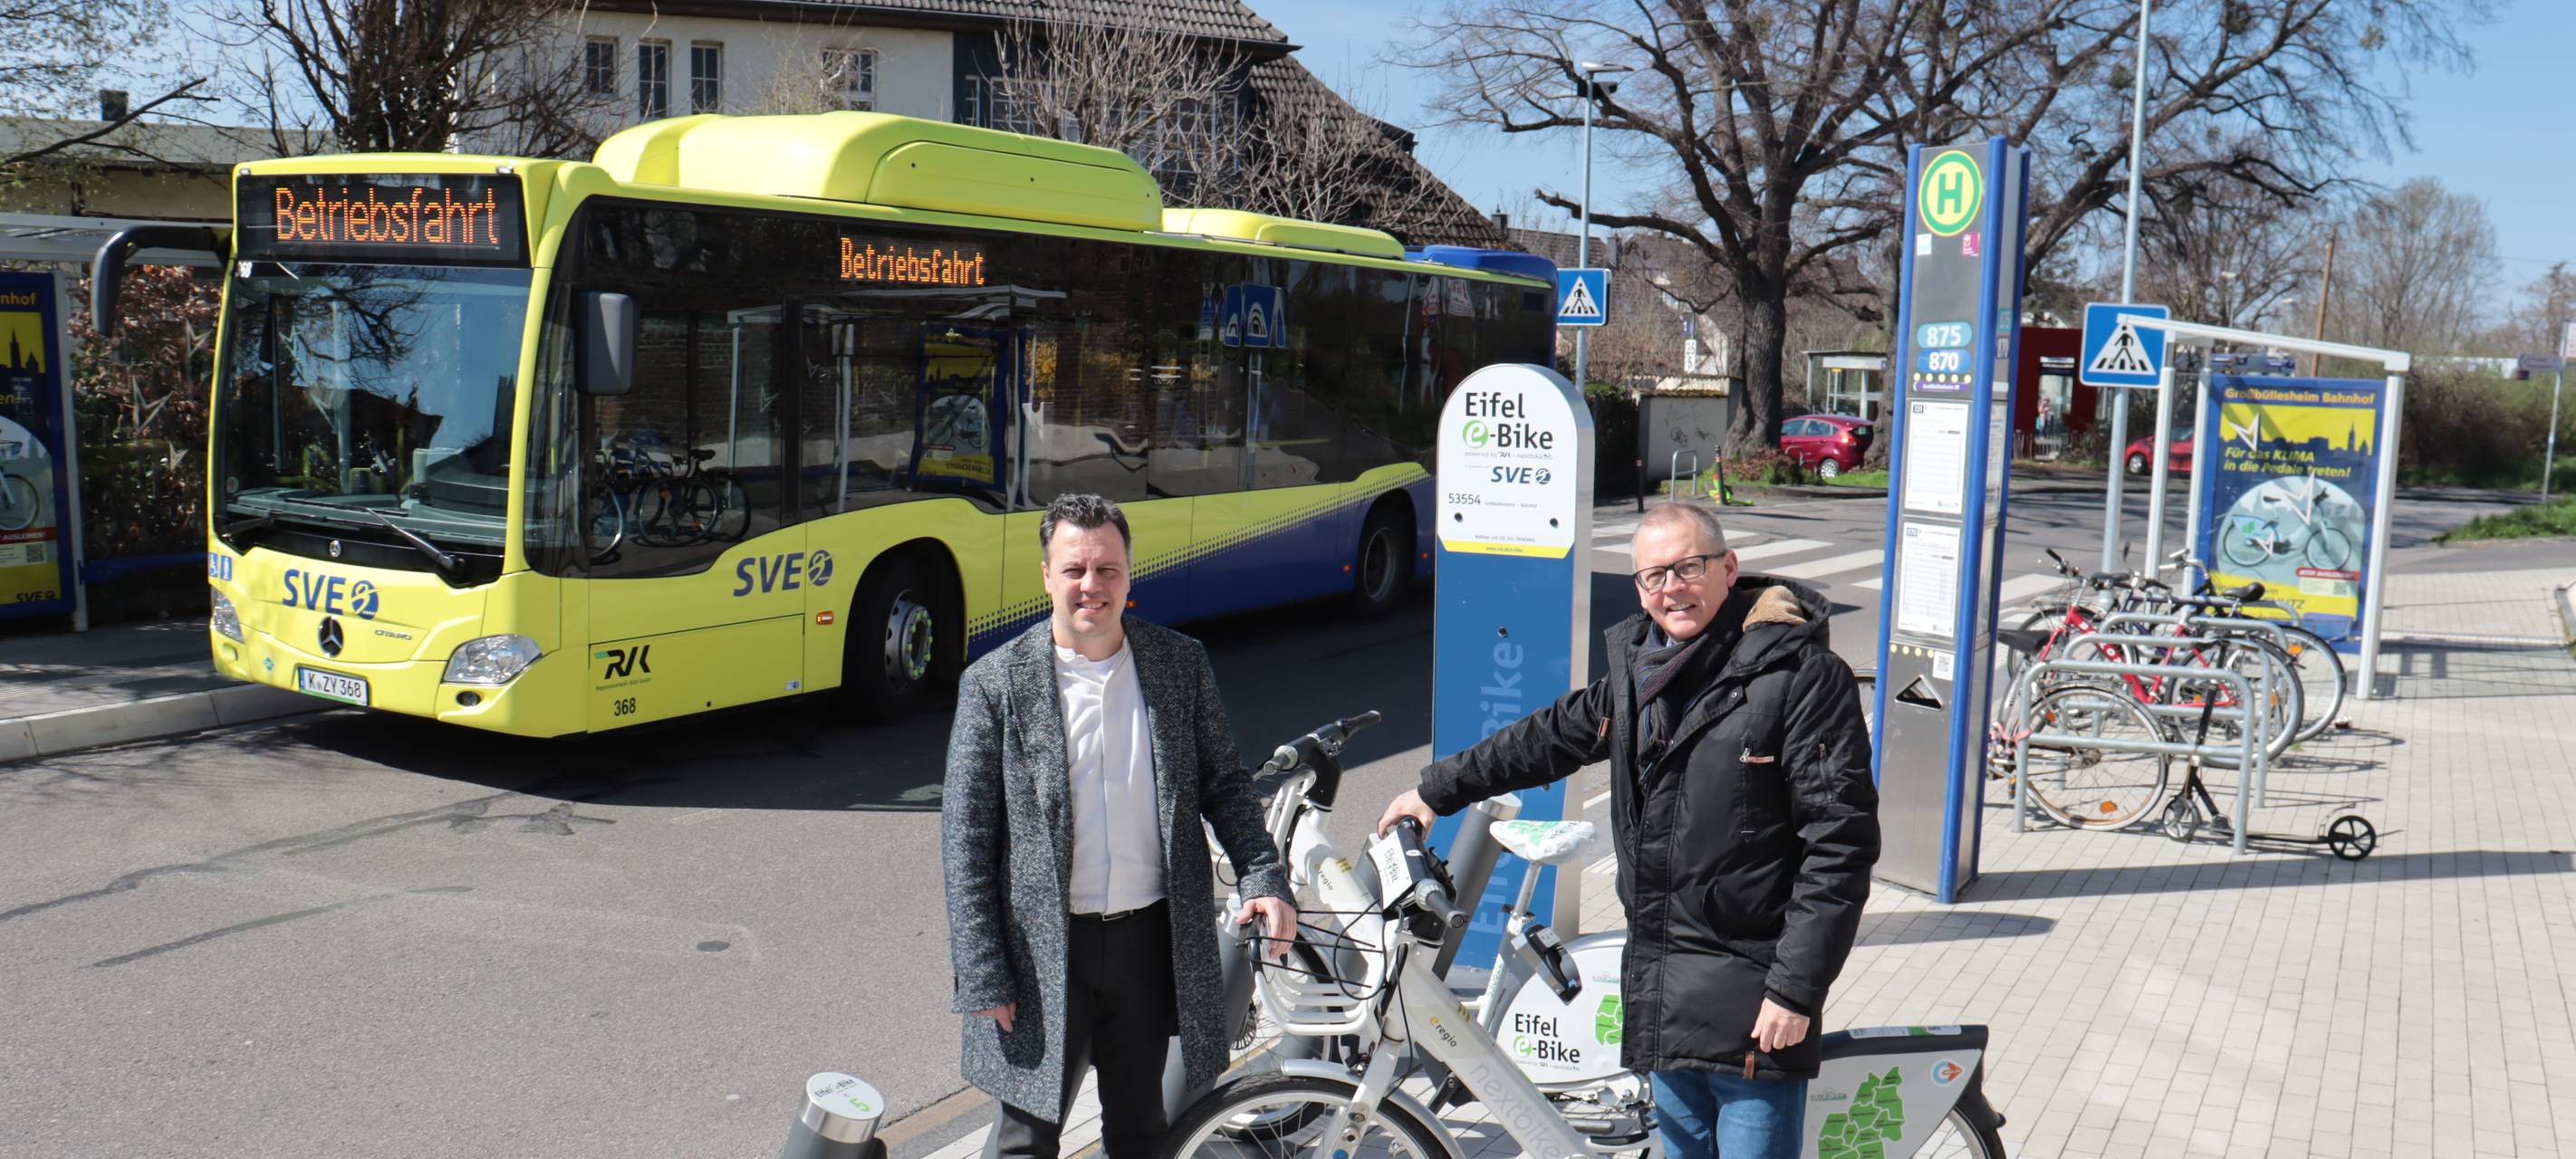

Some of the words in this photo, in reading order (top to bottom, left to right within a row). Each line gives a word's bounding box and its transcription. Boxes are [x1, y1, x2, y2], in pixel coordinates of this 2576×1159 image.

[1937, 172, 1963, 215] H
[276, 187, 498, 243] Betriebsfahrt
[841, 237, 985, 285] Betriebsfahrt
[1927, 325, 1962, 347] 875
[1928, 351, 1960, 371] 870
[1465, 391, 1525, 418] Eifel
[2225, 387, 2320, 403] Großbüllesheim
[2322, 392, 2375, 405] Bahnhof
[1463, 419, 1553, 450] e-Bike
[2225, 445, 2246, 459] Für
[2273, 449, 2315, 464] KLIMA
[1491, 465, 1533, 484] SVE
[2224, 459, 2236, 472] in
[2239, 460, 2260, 473] die
[2306, 465, 2352, 479] treten!
[1448, 493, 1481, 505] 53554
[733, 552, 805, 598] SVE
[15, 590, 44, 603] SVE
[283, 569, 348, 616] SVE
[341, 678, 362, 699] 368
[614, 697, 637, 717] 368
[1514, 1013, 1559, 1039] Eifel
[1514, 1035, 1581, 1064] e-Bike
[1469, 1061, 1562, 1159] nextbike
